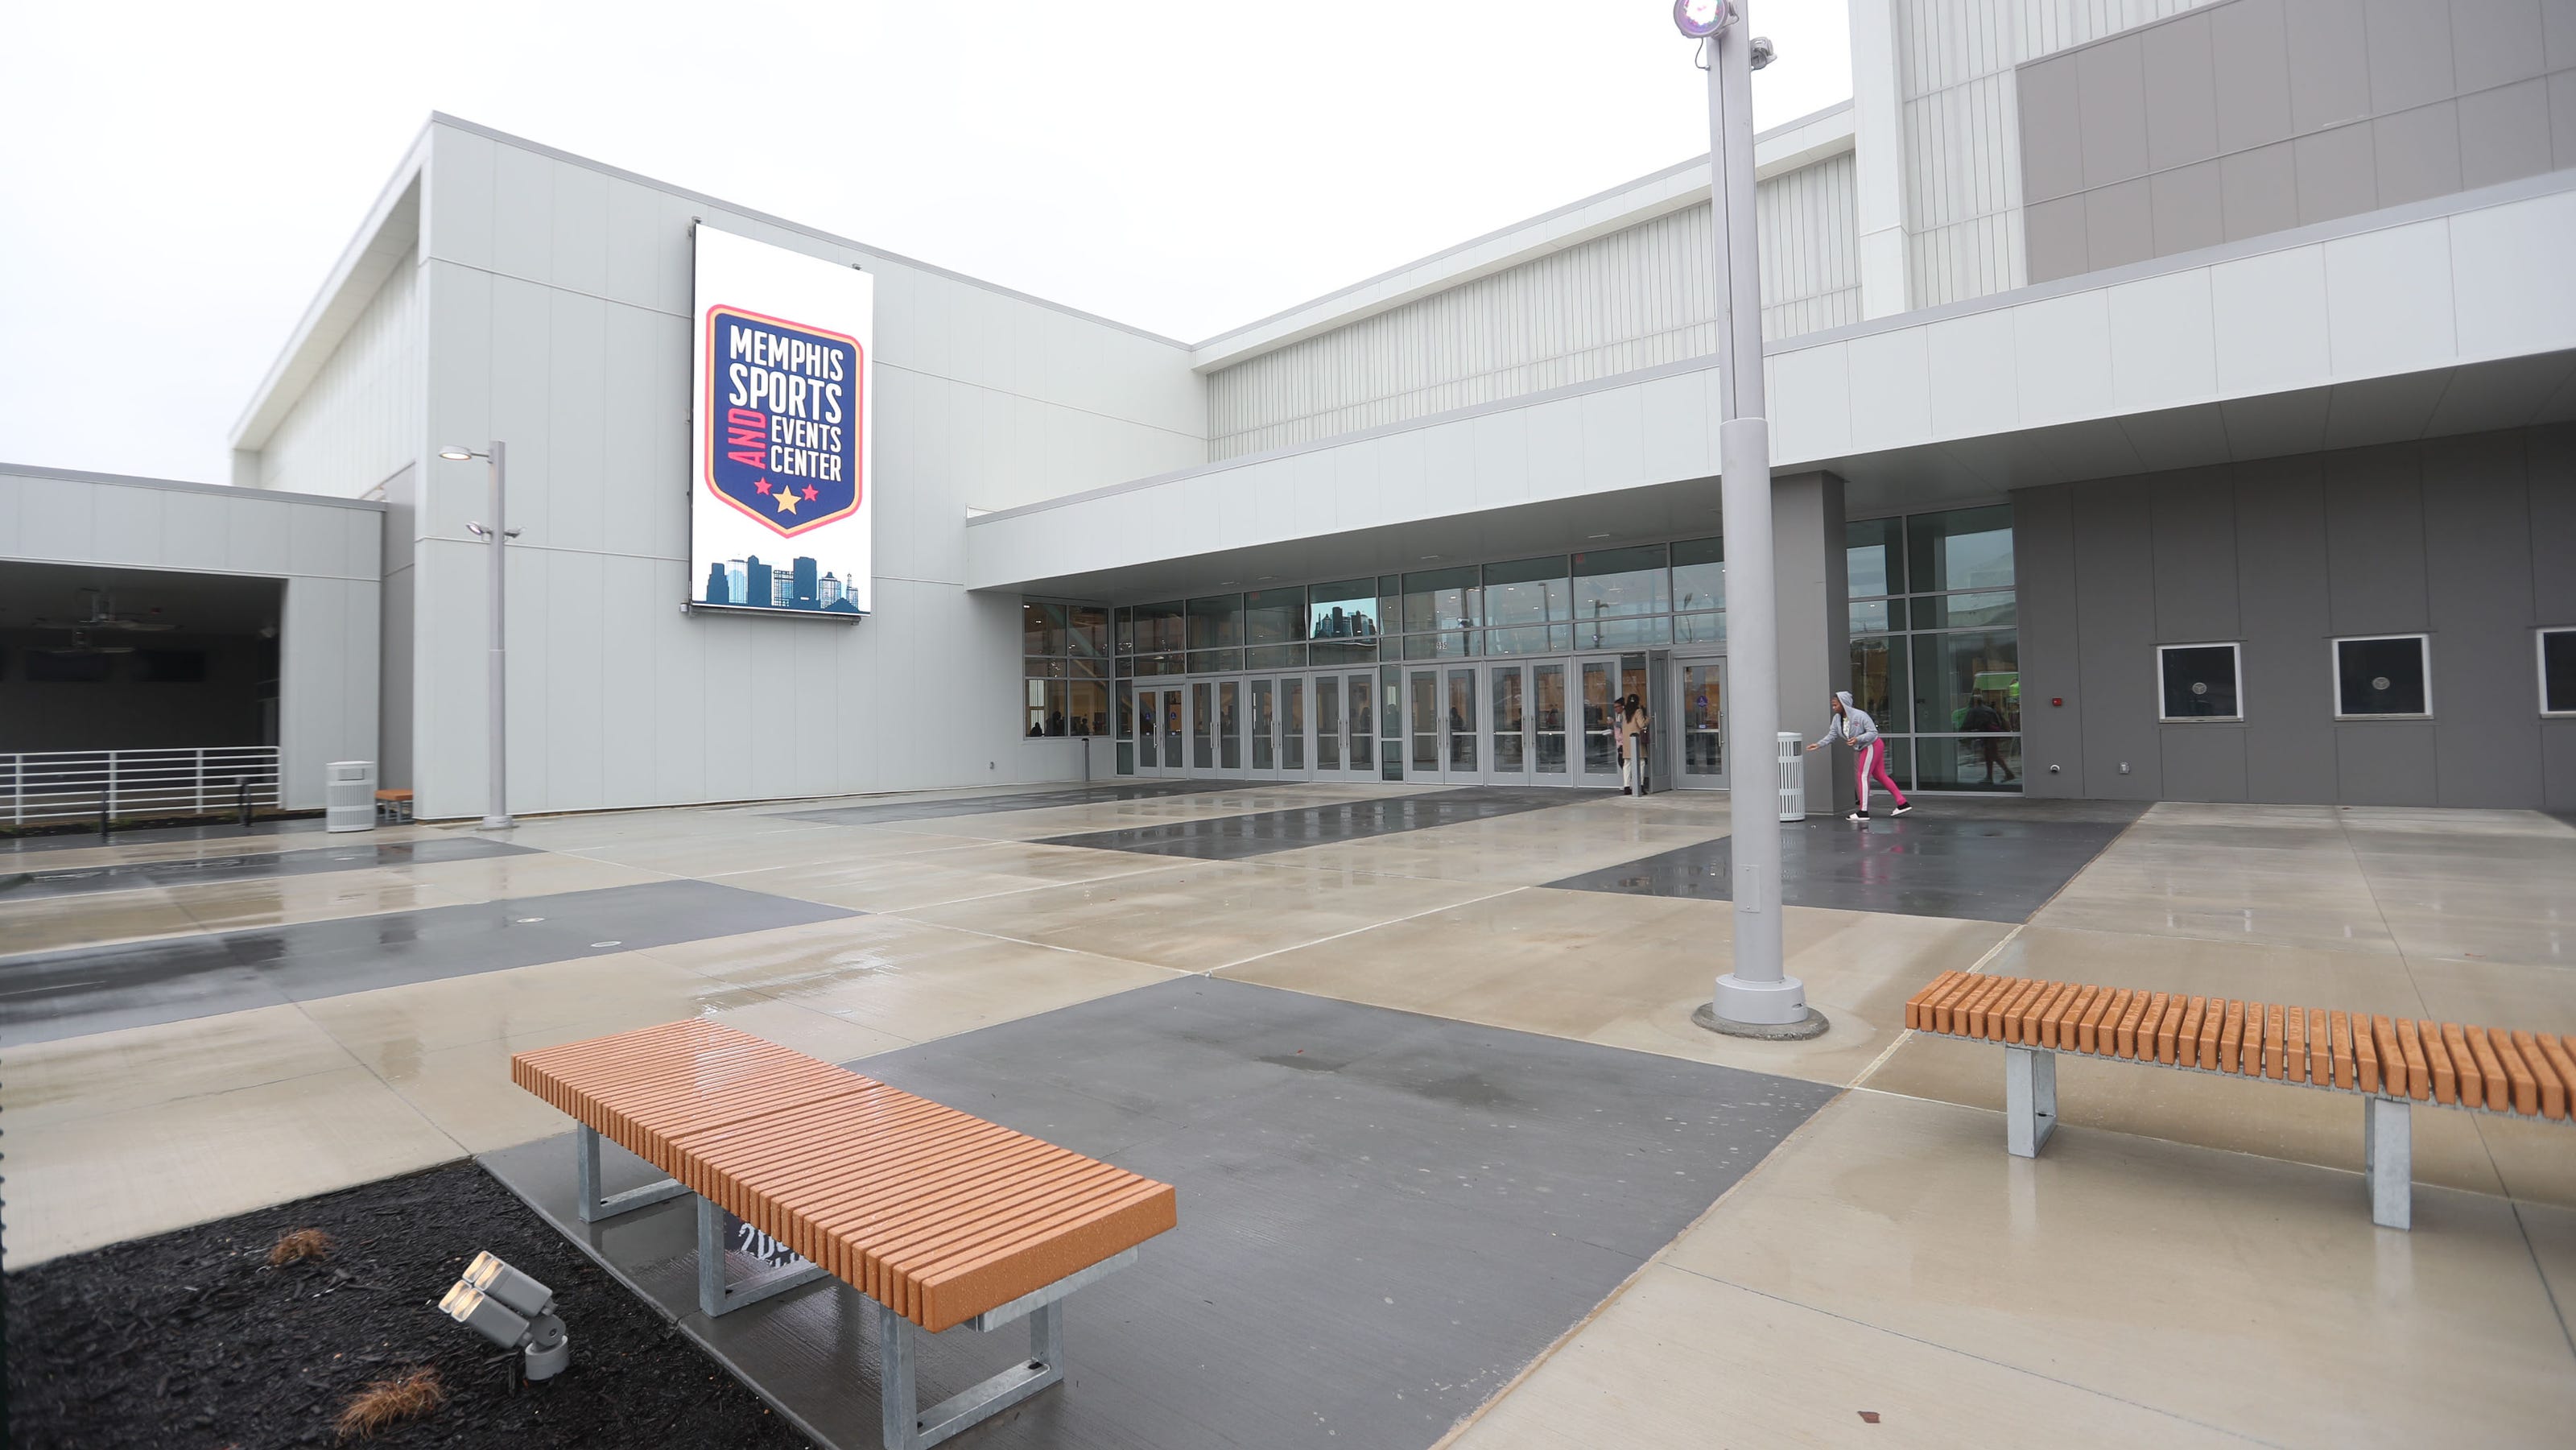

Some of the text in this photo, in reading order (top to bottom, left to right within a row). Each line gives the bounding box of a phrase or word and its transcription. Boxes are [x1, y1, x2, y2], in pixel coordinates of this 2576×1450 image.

[729, 324, 844, 382] MEMPHIS
[729, 362, 842, 424] SPORTS
[728, 408, 767, 470] AND
[770, 415, 842, 453] EVENTS
[770, 444, 842, 482] CENTER
